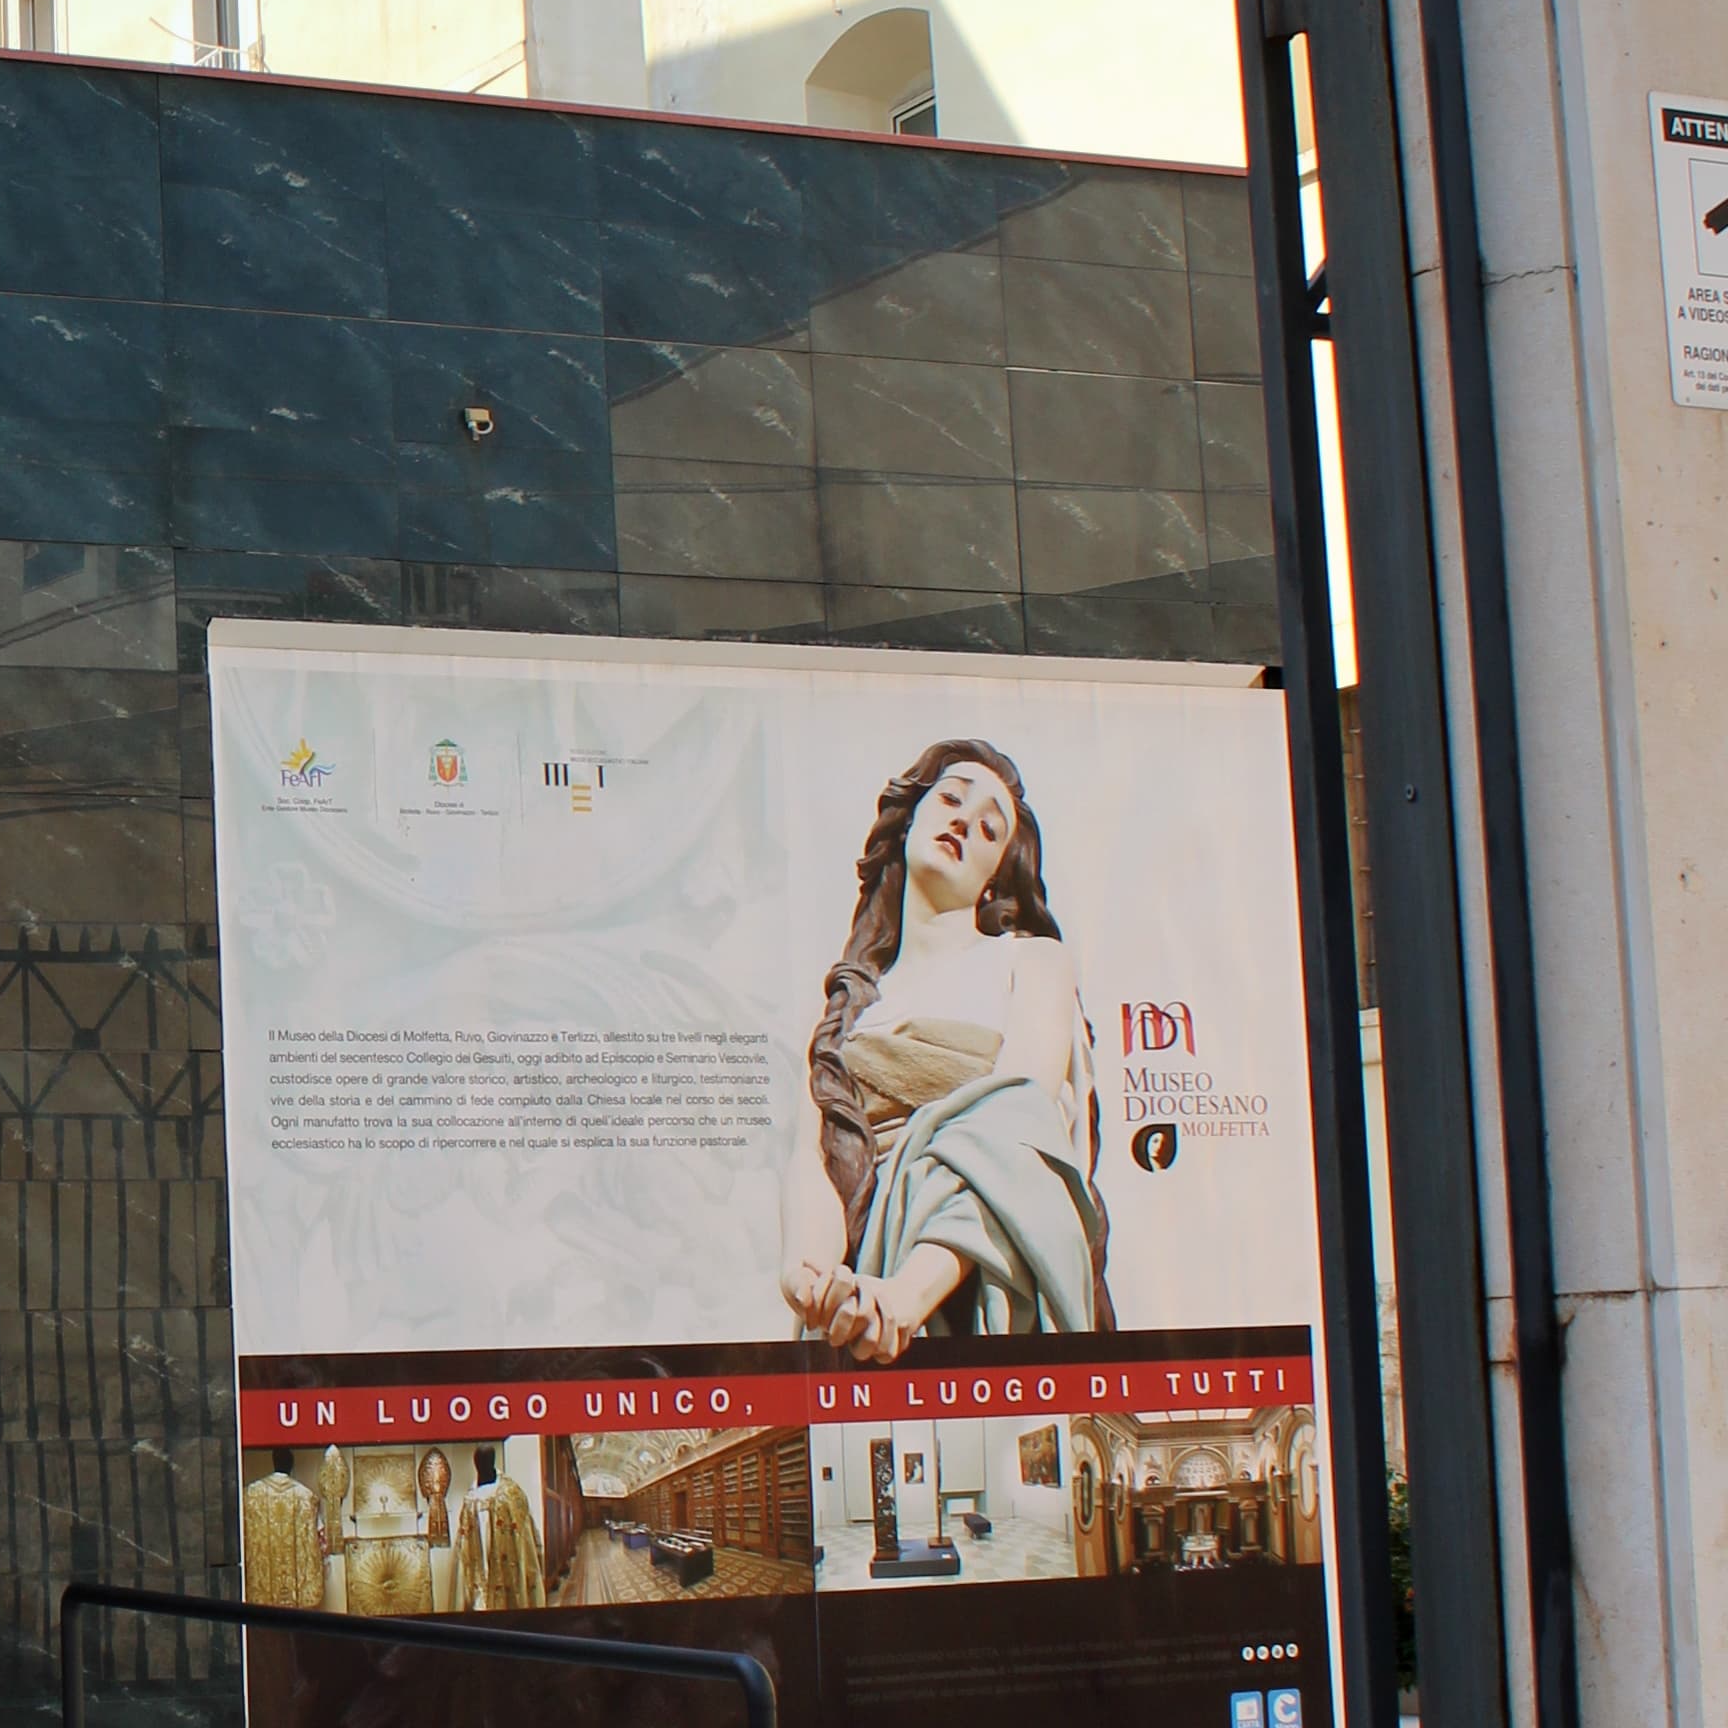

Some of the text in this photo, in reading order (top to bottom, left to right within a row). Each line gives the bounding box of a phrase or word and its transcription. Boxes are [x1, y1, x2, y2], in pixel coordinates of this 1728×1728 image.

[1688, 288, 1720, 303] AREA
[1678, 305, 1686, 320] A
[268, 1029, 768, 1045] Il Museo della Diocesi di Molfetta, Ruvo, Giovinazzo e Terlizzi, allestito su tre livelli negli eleganti
[269, 1072, 770, 1087] custodisce opere di grande valore storico, artistico, archeologico e liturgico, testimonianze
[1124, 1068, 1212, 1093] MUSEO
[1124, 1095, 1268, 1122] DIOCESANO
[1182, 1122, 1270, 1136] MOLFETTA
[279, 1369, 1285, 1426] UN LUOGO UNICO, UN LUOGO DI TUTTI
